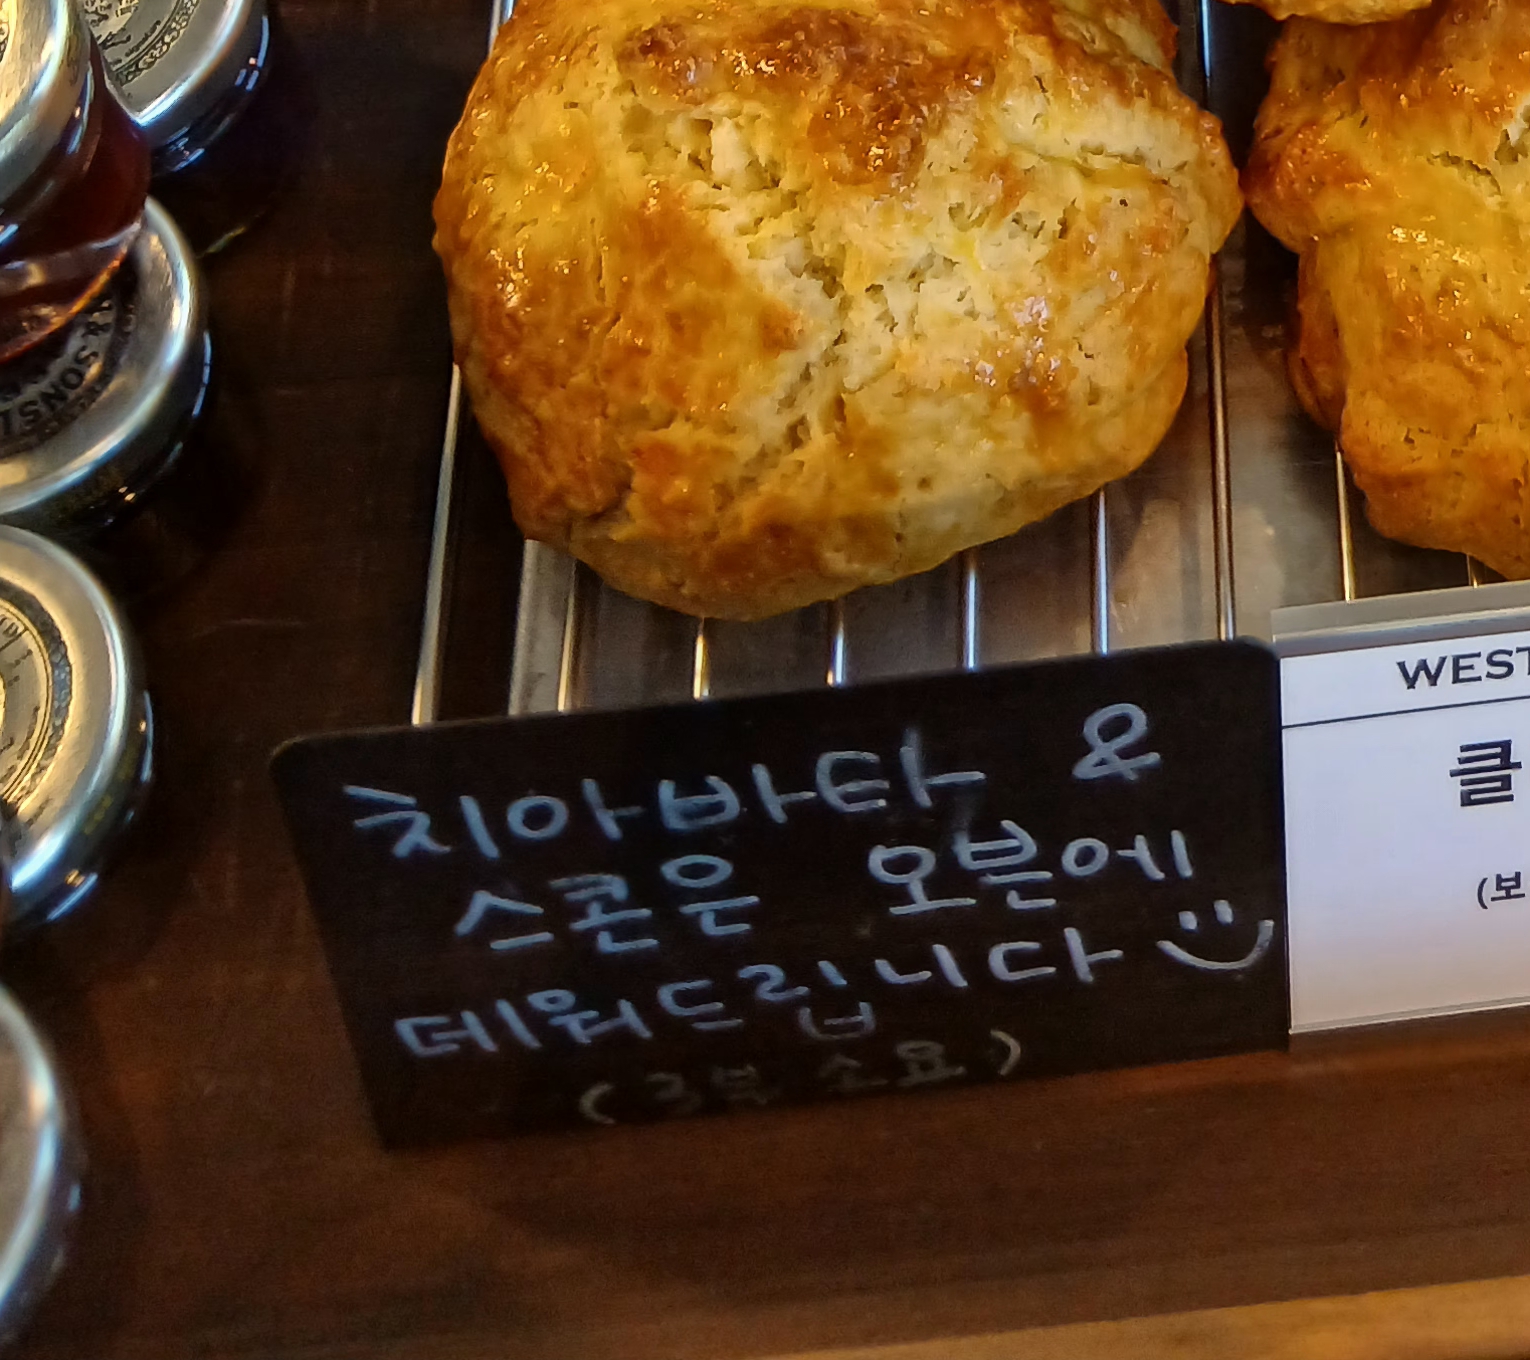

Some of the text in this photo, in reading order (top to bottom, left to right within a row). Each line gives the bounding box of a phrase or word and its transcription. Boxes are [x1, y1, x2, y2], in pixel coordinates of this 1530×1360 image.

[344, 701, 1160, 859] 치아바타 &
[454, 819, 1195, 954] 스콘은 오븐에
[393, 924, 1125, 1059] 데워드립니다
